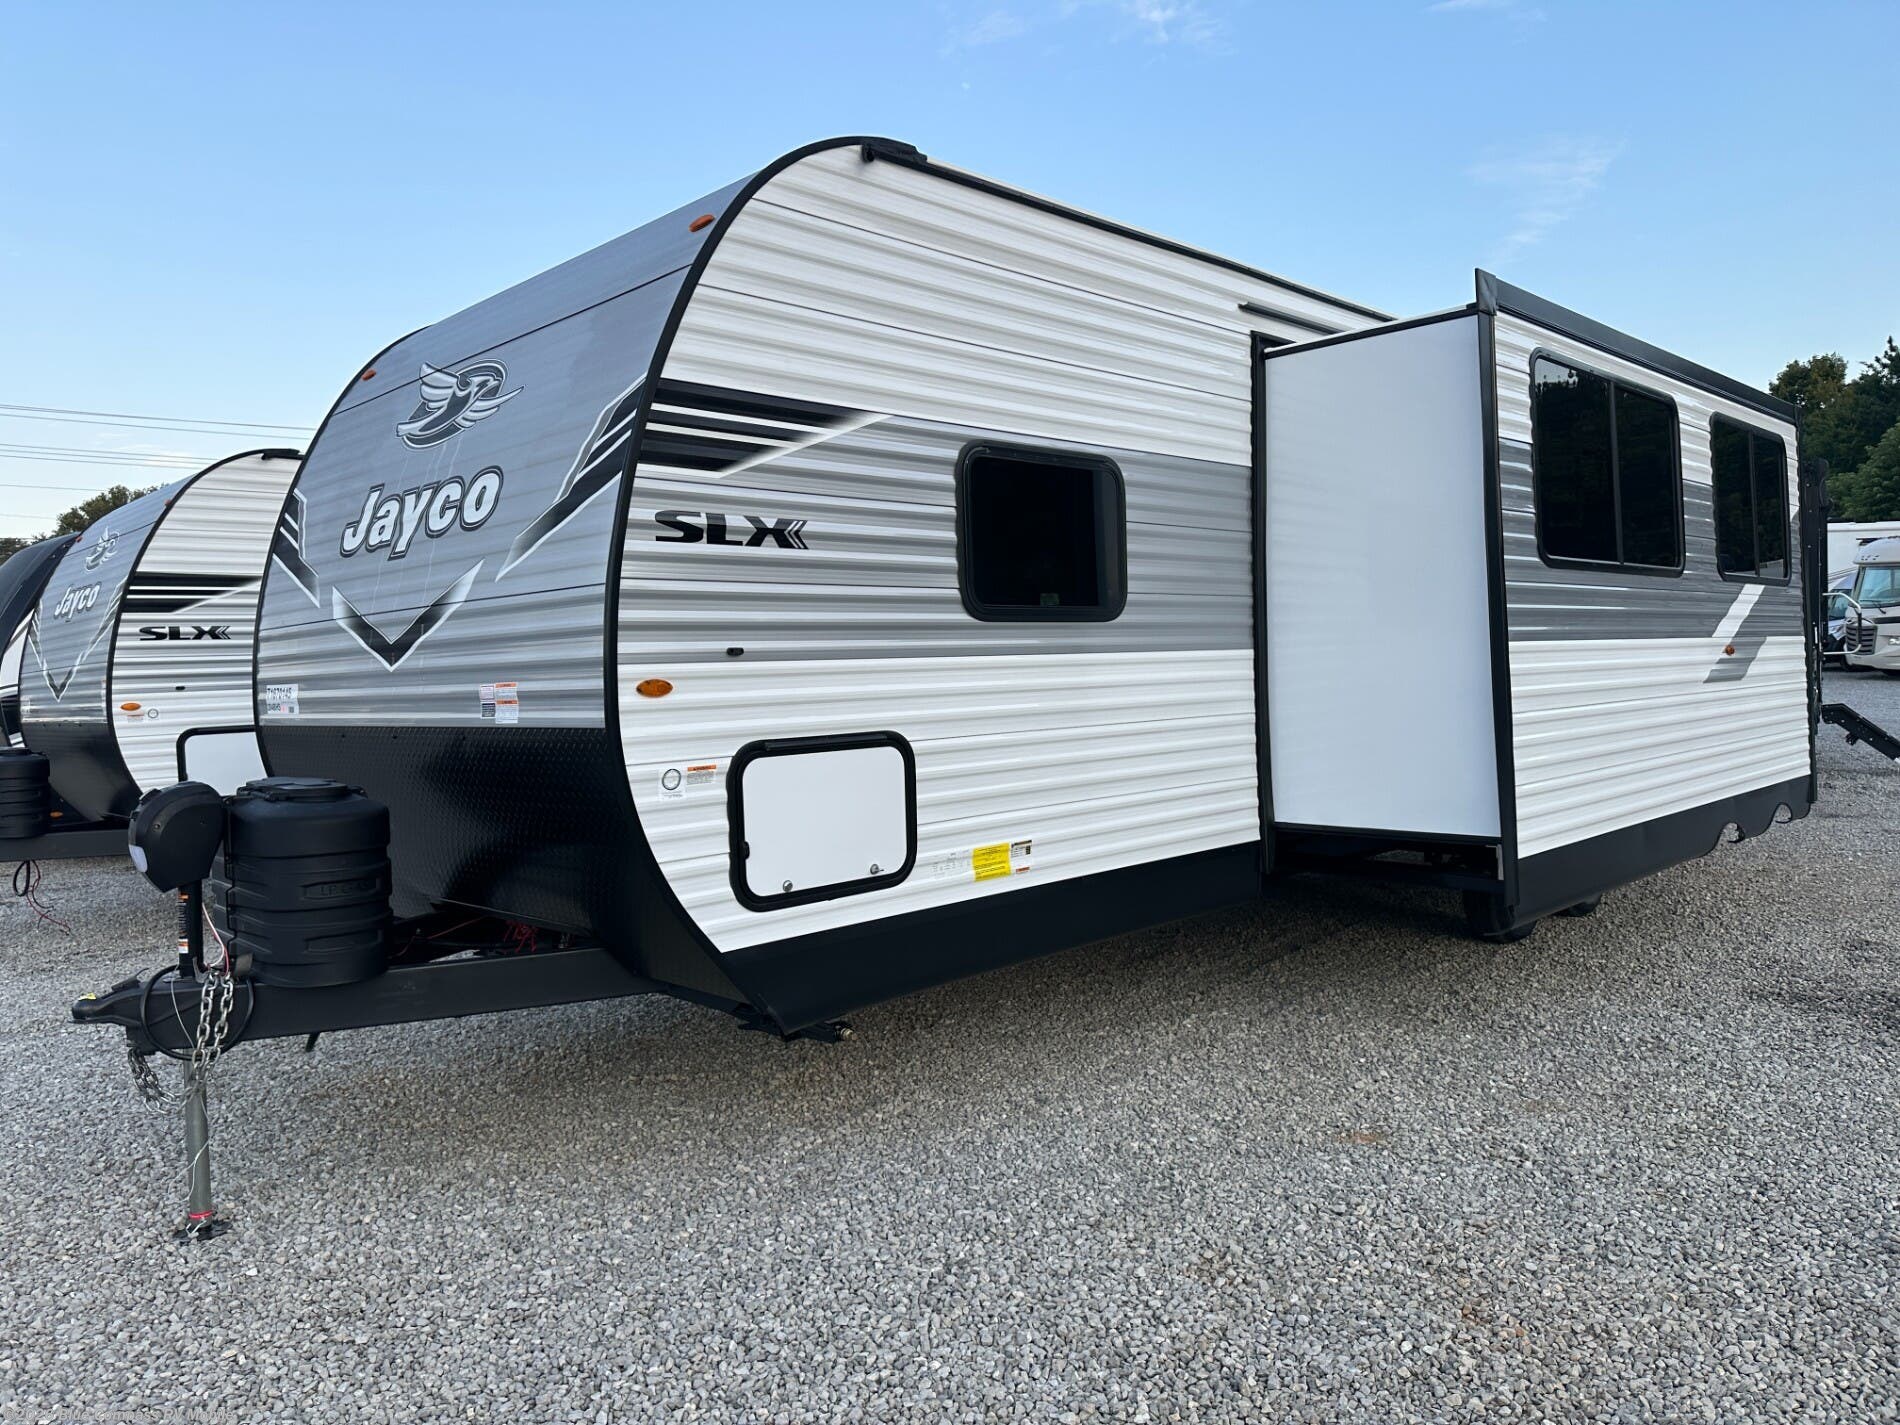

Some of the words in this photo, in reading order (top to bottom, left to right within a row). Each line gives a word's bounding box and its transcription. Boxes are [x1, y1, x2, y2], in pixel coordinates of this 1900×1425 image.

[340, 465, 504, 561] Jayco
[655, 510, 808, 550] SLX
[54, 582, 101, 622] Jayco
[139, 626, 231, 640] SLX
